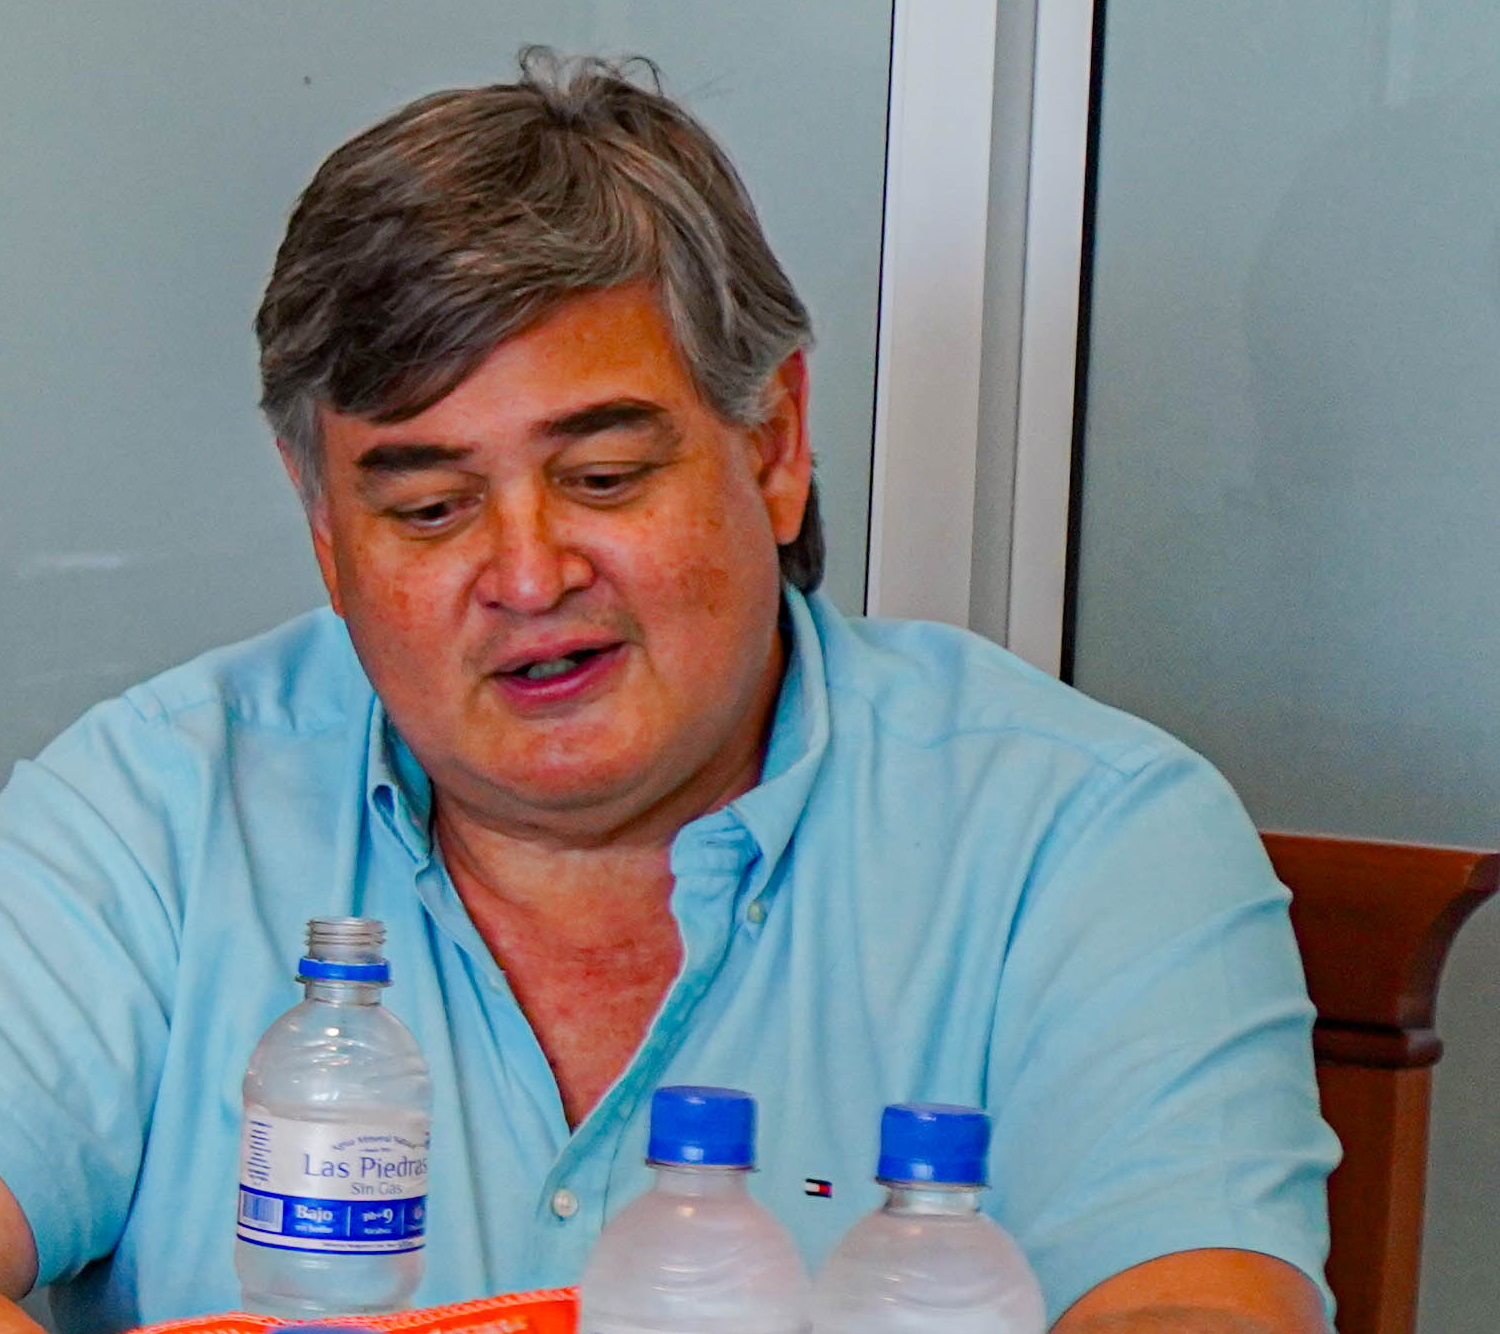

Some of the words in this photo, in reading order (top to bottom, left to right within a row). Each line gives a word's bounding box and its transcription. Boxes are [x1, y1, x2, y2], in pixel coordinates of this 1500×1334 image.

[304, 1152, 350, 1179] Las
[360, 1155, 428, 1179] Piedras
[350, 1181, 375, 1195] Sin
[379, 1181, 404, 1195] Gas
[294, 1204, 334, 1223] Bajo
